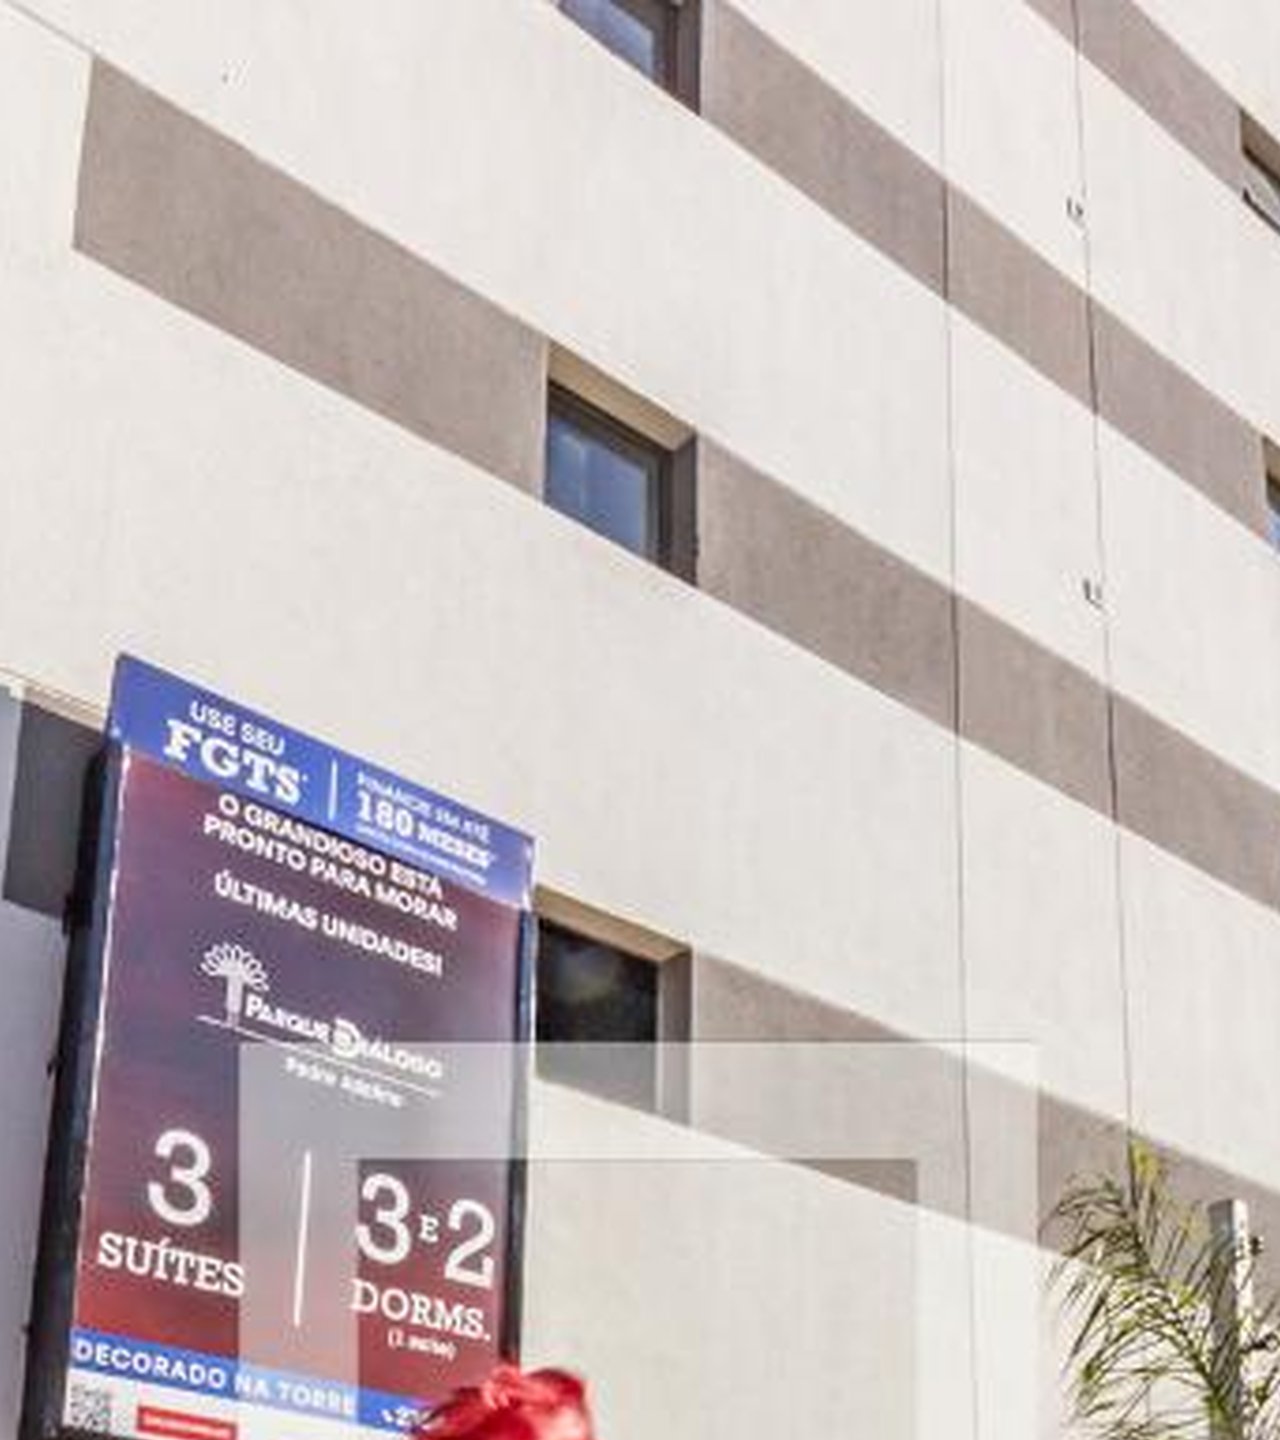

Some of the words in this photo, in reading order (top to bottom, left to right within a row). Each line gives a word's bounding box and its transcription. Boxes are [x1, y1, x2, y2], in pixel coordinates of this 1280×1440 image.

[189, 700, 237, 736] USE
[240, 722, 286, 756] SEU
[357, 789, 414, 837] 180
[203, 813, 308, 871] PRONTO
[310, 857, 371, 899] PARA
[374, 882, 458, 932] MORAR
[219, 793, 240, 817] O
[243, 803, 387, 876] GRANDIOSO
[389, 858, 444, 900] ESTÁ
[214, 868, 319, 931] ÚLTIMAS
[147, 1129, 212, 1227] 3
[355, 1172, 411, 1265] 3
[418, 1213, 440, 1243] E
[444, 1198, 495, 1288] 2
[97, 1231, 245, 1298] SUÍTES
[349, 1277, 492, 1342] DORMS.
[75, 1338, 228, 1389] DECORADO
[233, 1373, 270, 1400] NA
